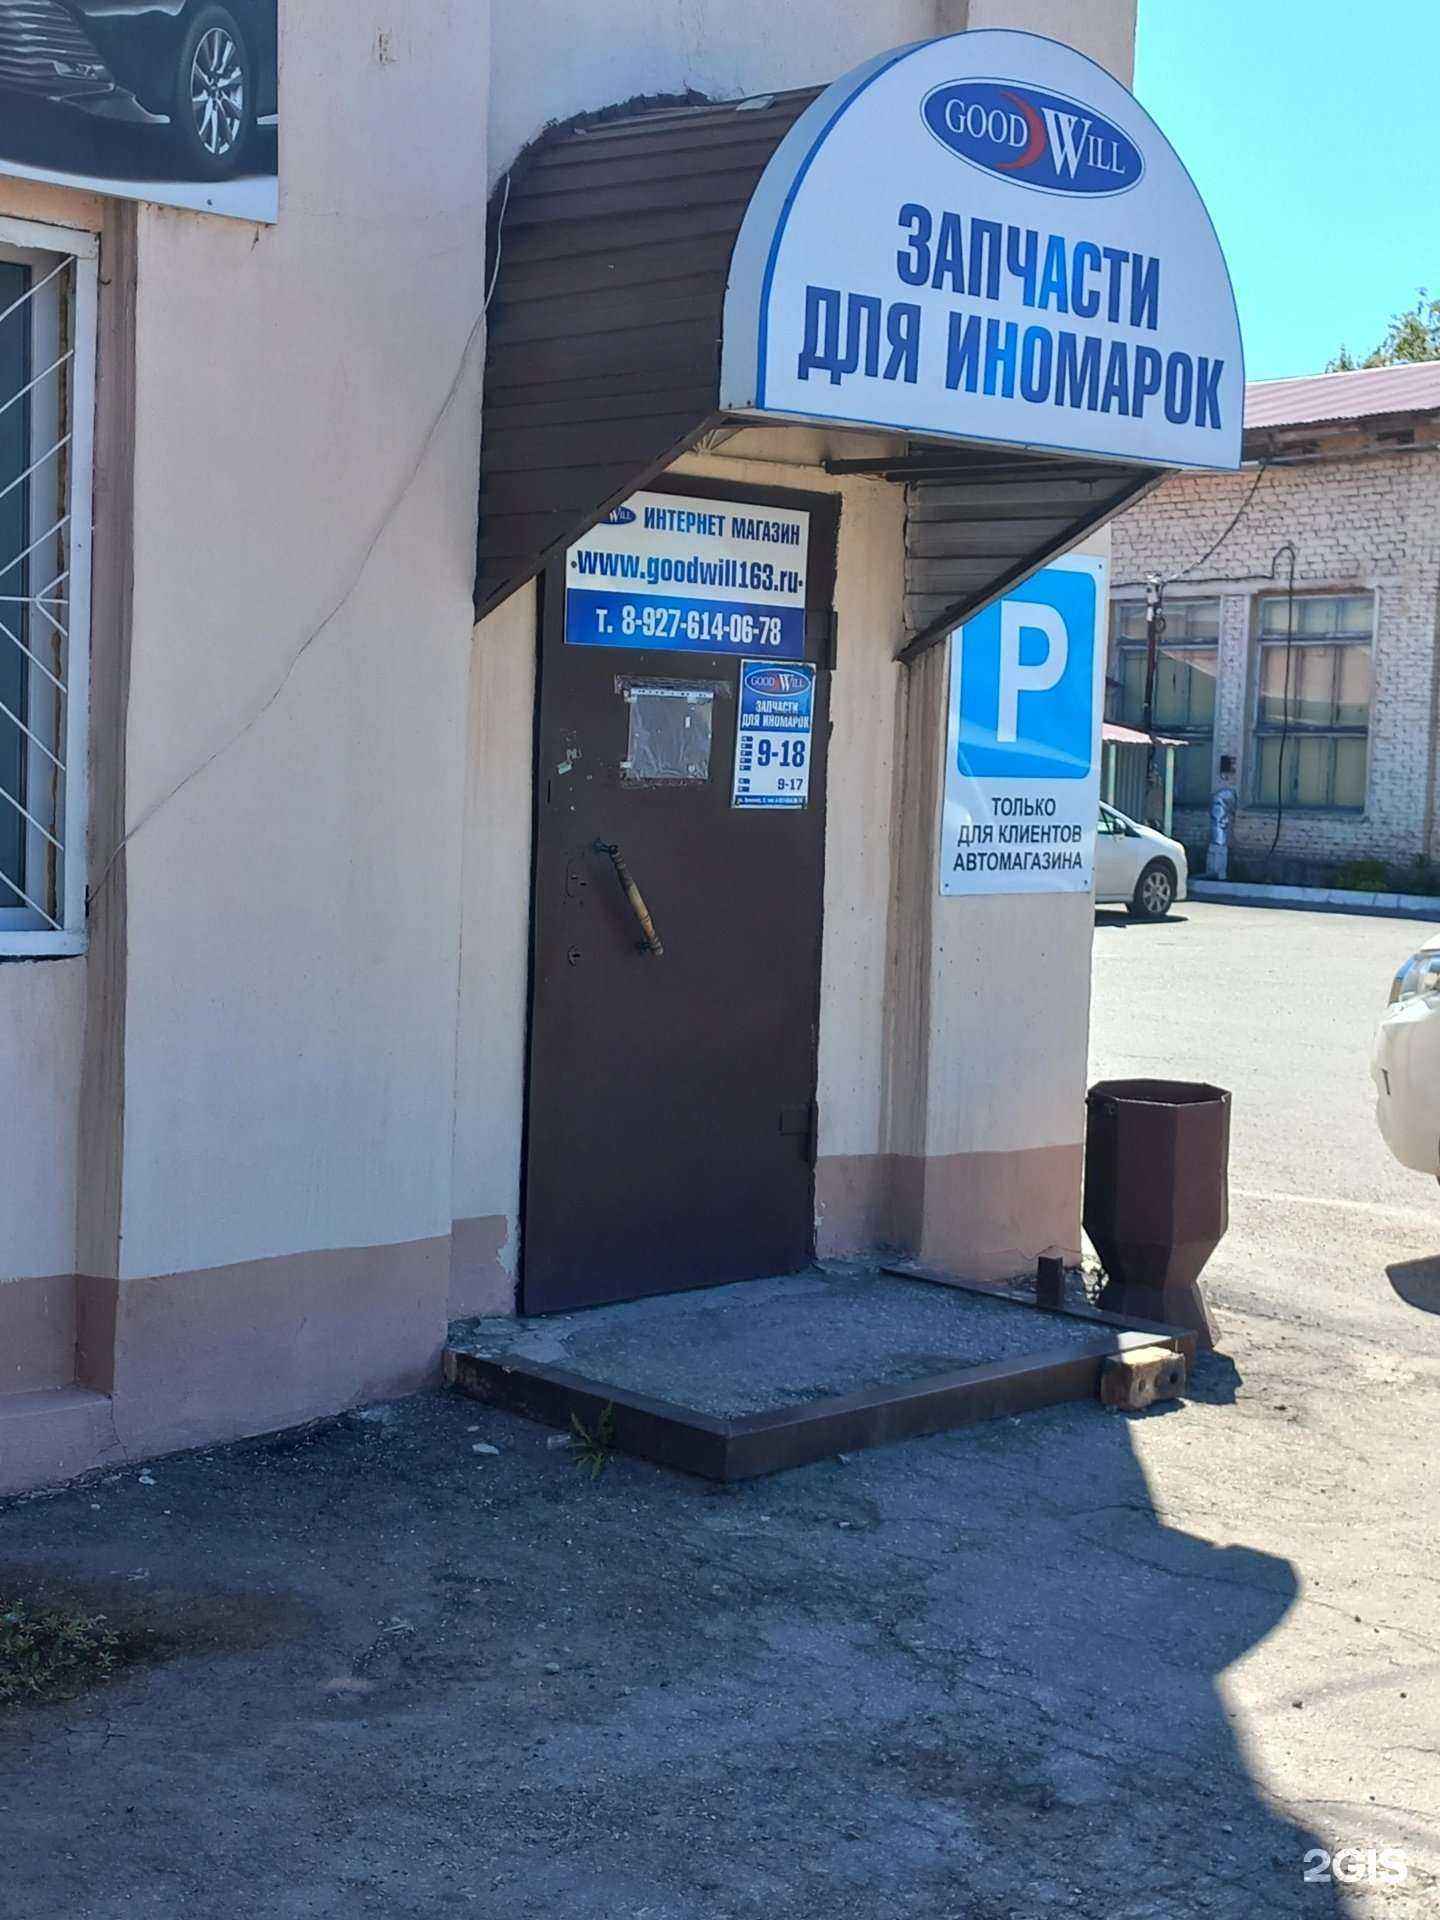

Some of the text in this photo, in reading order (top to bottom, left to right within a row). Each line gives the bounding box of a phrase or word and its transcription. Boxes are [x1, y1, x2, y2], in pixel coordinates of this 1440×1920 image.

[943, 97, 1126, 181] GOOD WILL
[896, 202, 1161, 331] ЗАПЧАСТИ
[797, 285, 1225, 430] ДЛЯ ИНОМАРОК
[643, 506, 800, 546] ИНТЕРНЕТ МАГАЗИН
[577, 550, 799, 594] www.goodwill163.ru
[621, 605, 782, 646] 8-927-614-06-78
[750, 675, 775, 687] GOOD
[996, 600, 1069, 743] P
[742, 713, 810, 729] ДЛЯ ИНОМАРОК
[755, 700, 799, 713] ЗАПЧАСТИ
[757, 738, 806, 768] 9-18
[777, 778, 803, 791] 9-17
[991, 797, 1056, 817] ТОЛЬКО
[957, 824, 1082, 847] ДЛЯ КЛИЕНТОВ
[953, 851, 1083, 872] АВТОМАГАЗИНА
